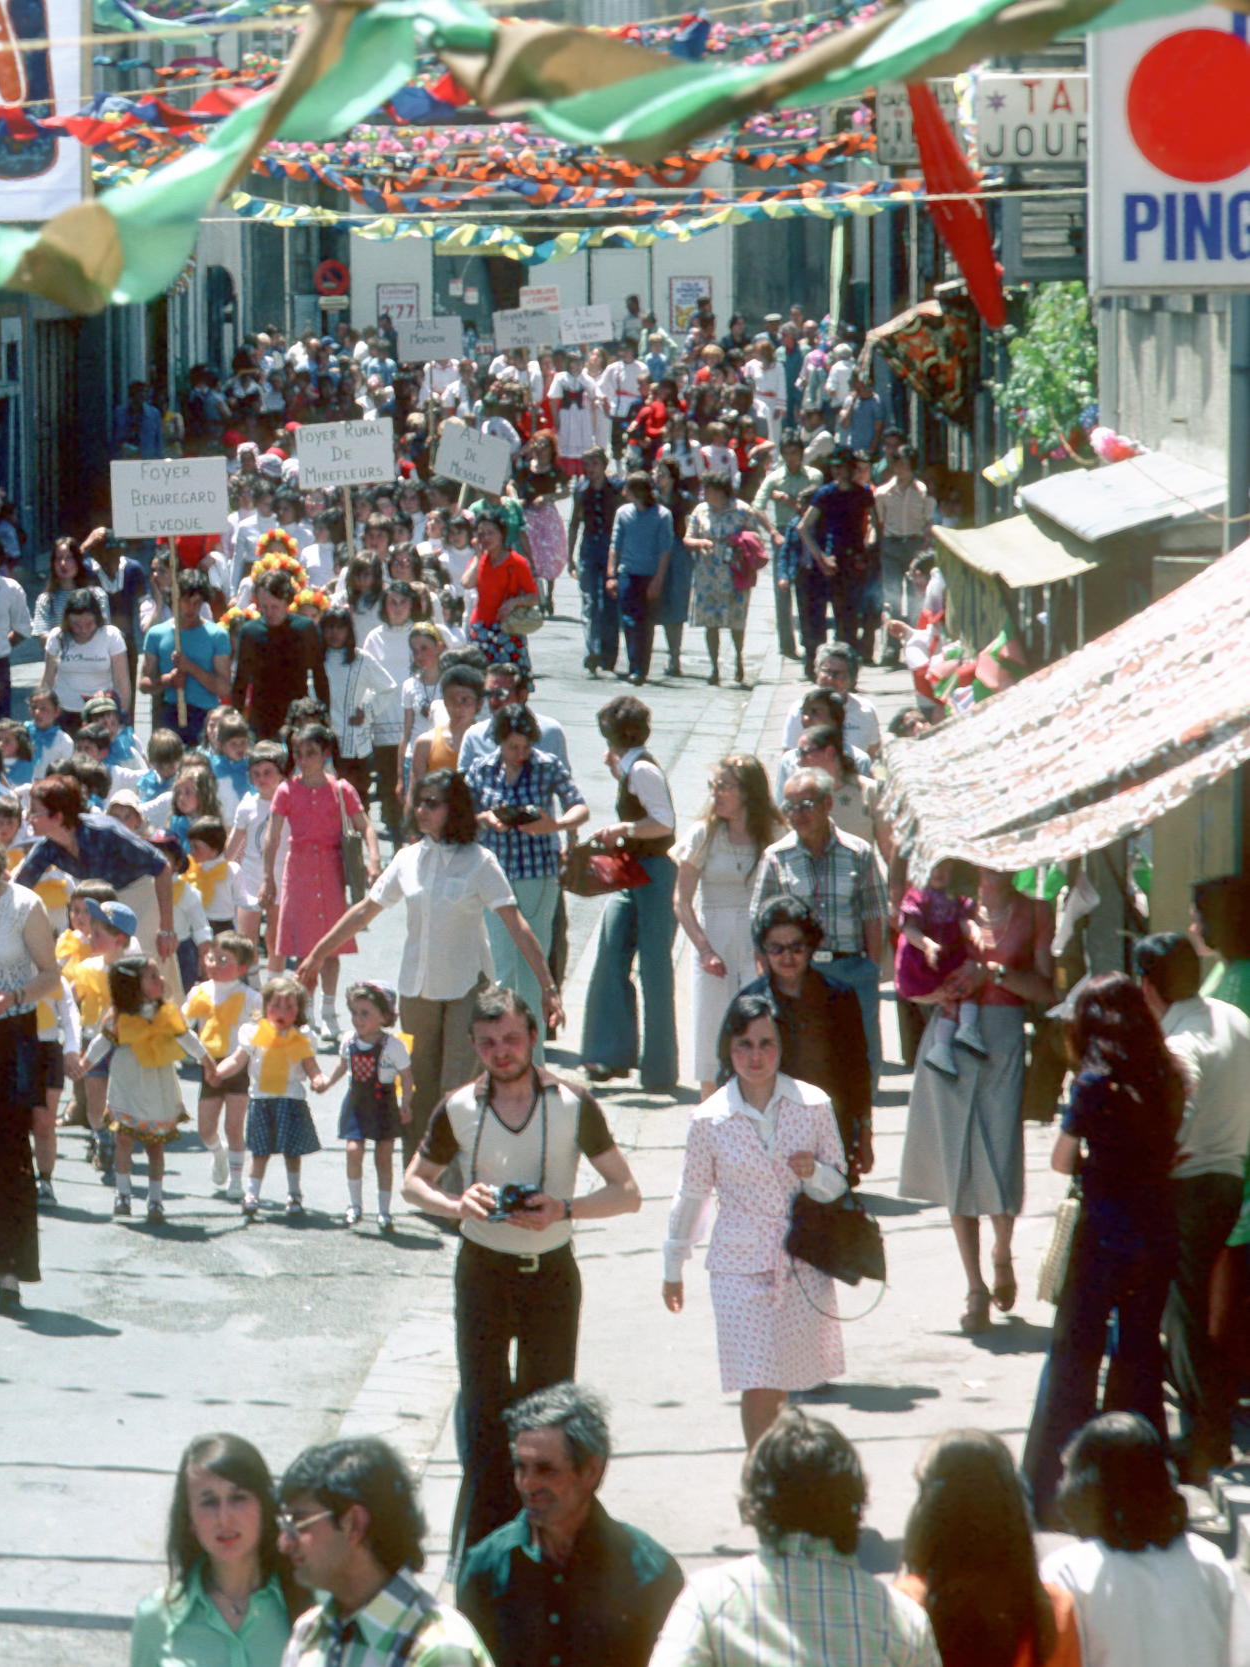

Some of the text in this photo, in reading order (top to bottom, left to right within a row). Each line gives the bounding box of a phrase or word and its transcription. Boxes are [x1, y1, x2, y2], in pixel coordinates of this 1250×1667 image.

[299, 421, 384, 446] FOYER RURAL
[141, 463, 191, 486] FOYER
[305, 466, 384, 484] MIREFLEURS
[131, 489, 216, 507] BEAUREGARD
